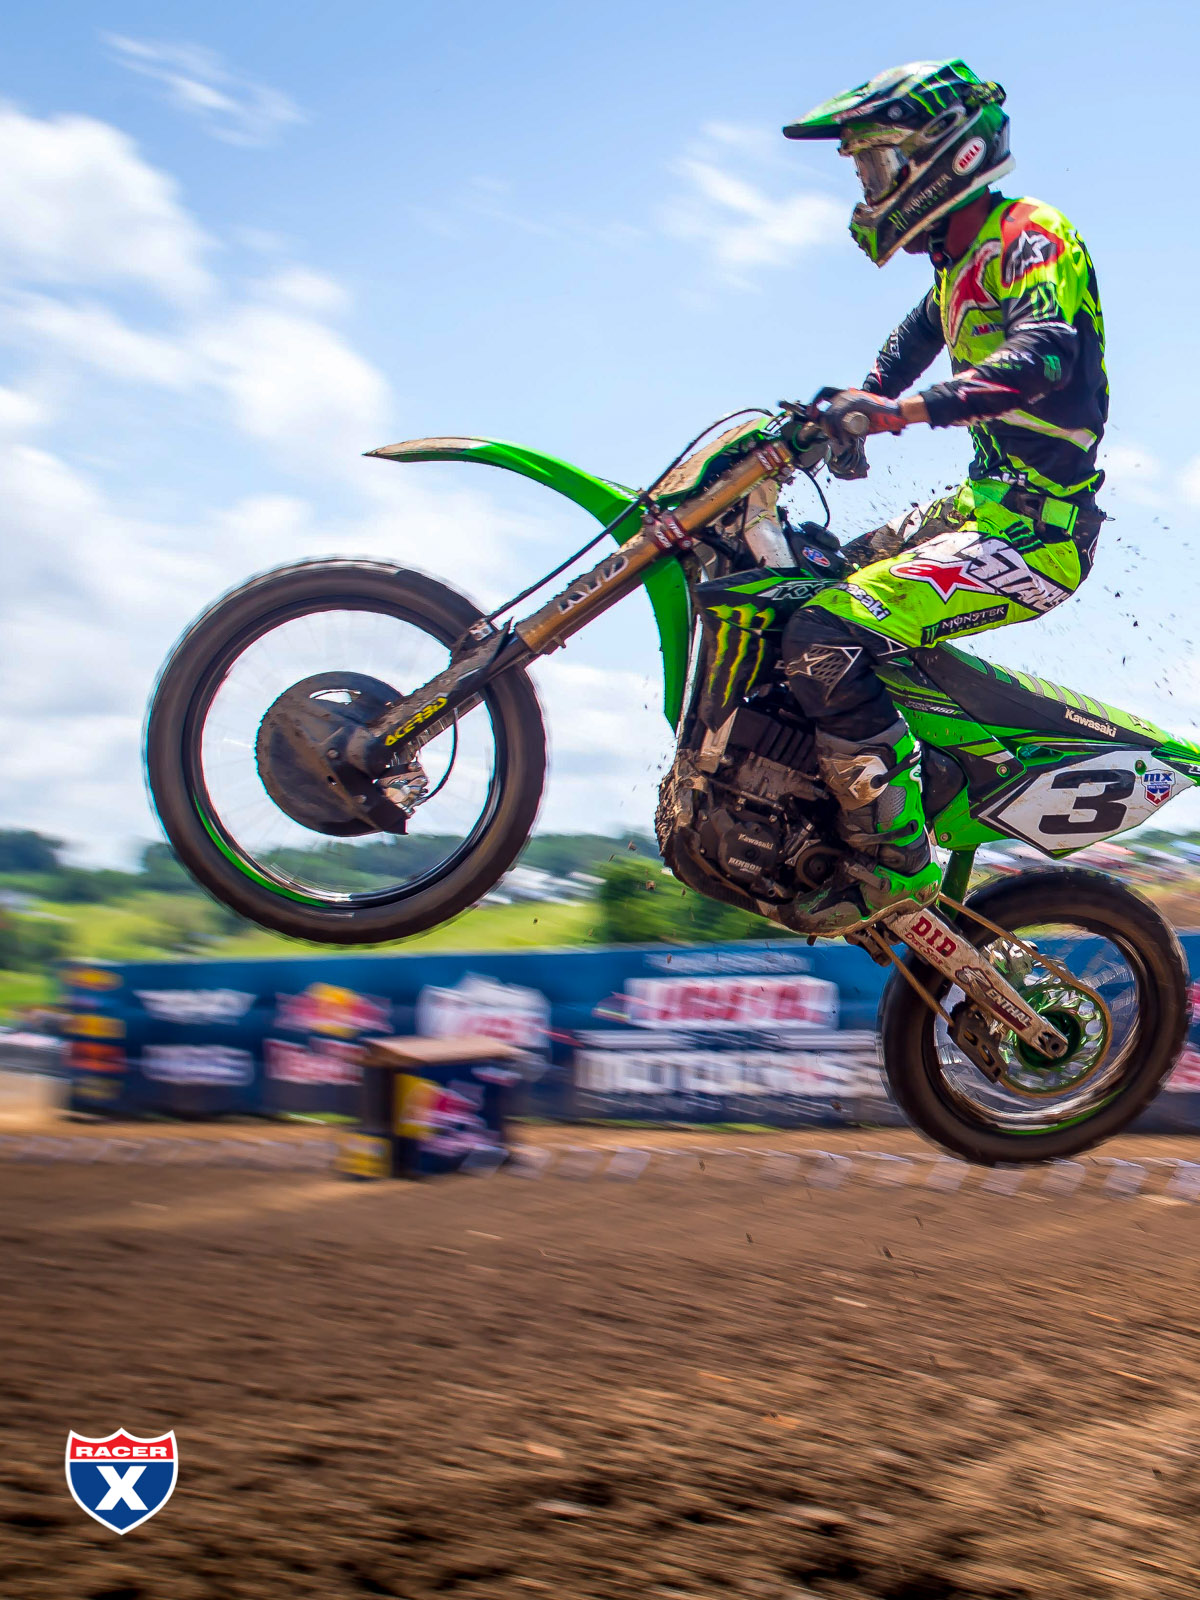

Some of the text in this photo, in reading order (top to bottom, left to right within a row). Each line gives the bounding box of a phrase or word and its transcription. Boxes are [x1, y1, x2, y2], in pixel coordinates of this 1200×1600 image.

[958, 144, 981, 170] BELL
[941, 606, 1005, 629] MONSTER
[1064, 707, 1118, 739] Kawasaki
[1038, 768, 1137, 835] 3
[737, 832, 775, 851] Kawasaki
